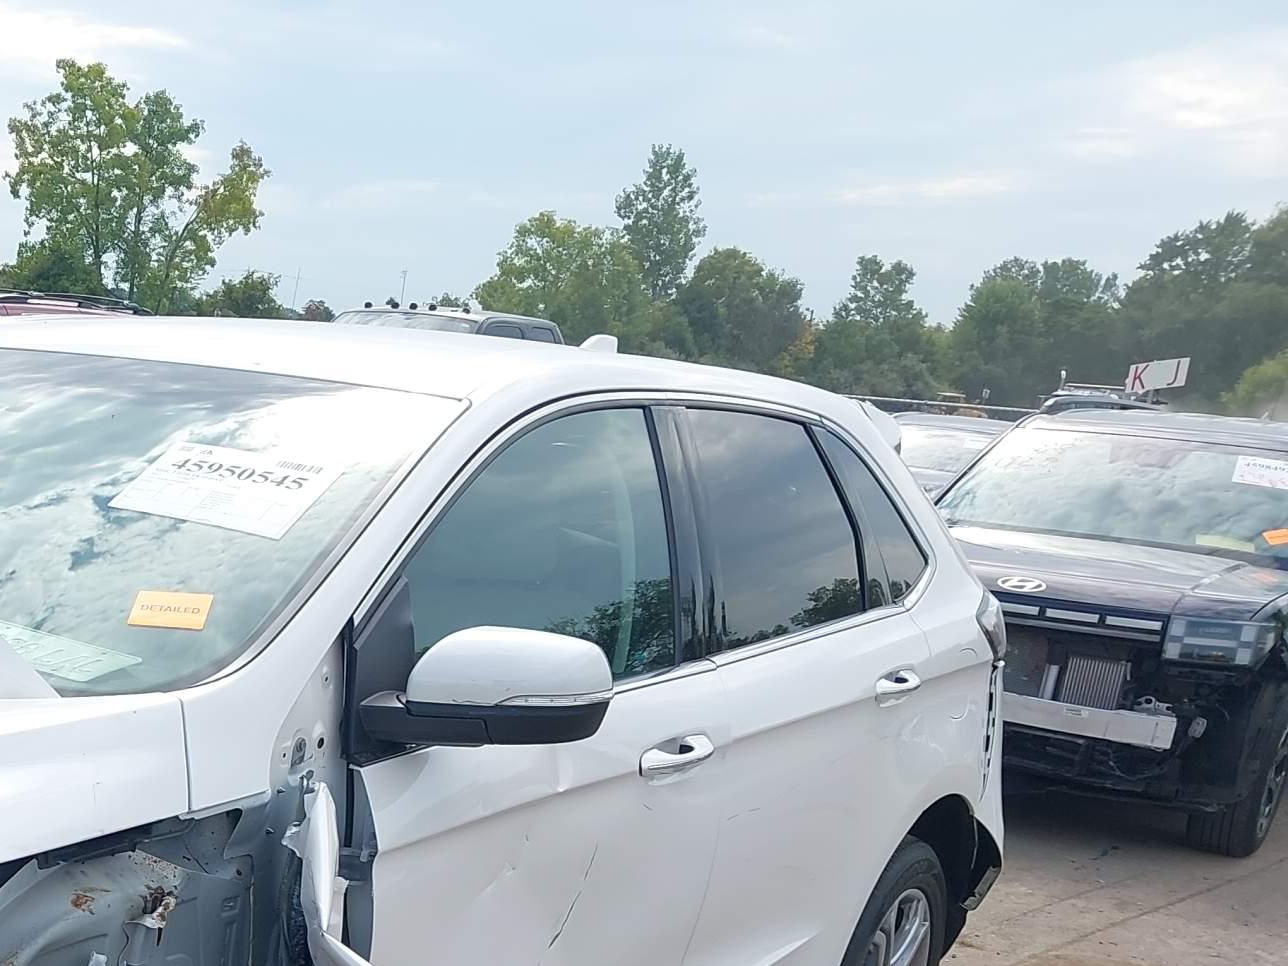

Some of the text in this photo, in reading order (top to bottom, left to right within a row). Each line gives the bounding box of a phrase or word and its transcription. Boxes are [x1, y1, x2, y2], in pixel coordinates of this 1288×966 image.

[1131, 359, 1182, 391] K J
[170, 458, 310, 491] 45950545
[140, 604, 201, 615] DETAILED
